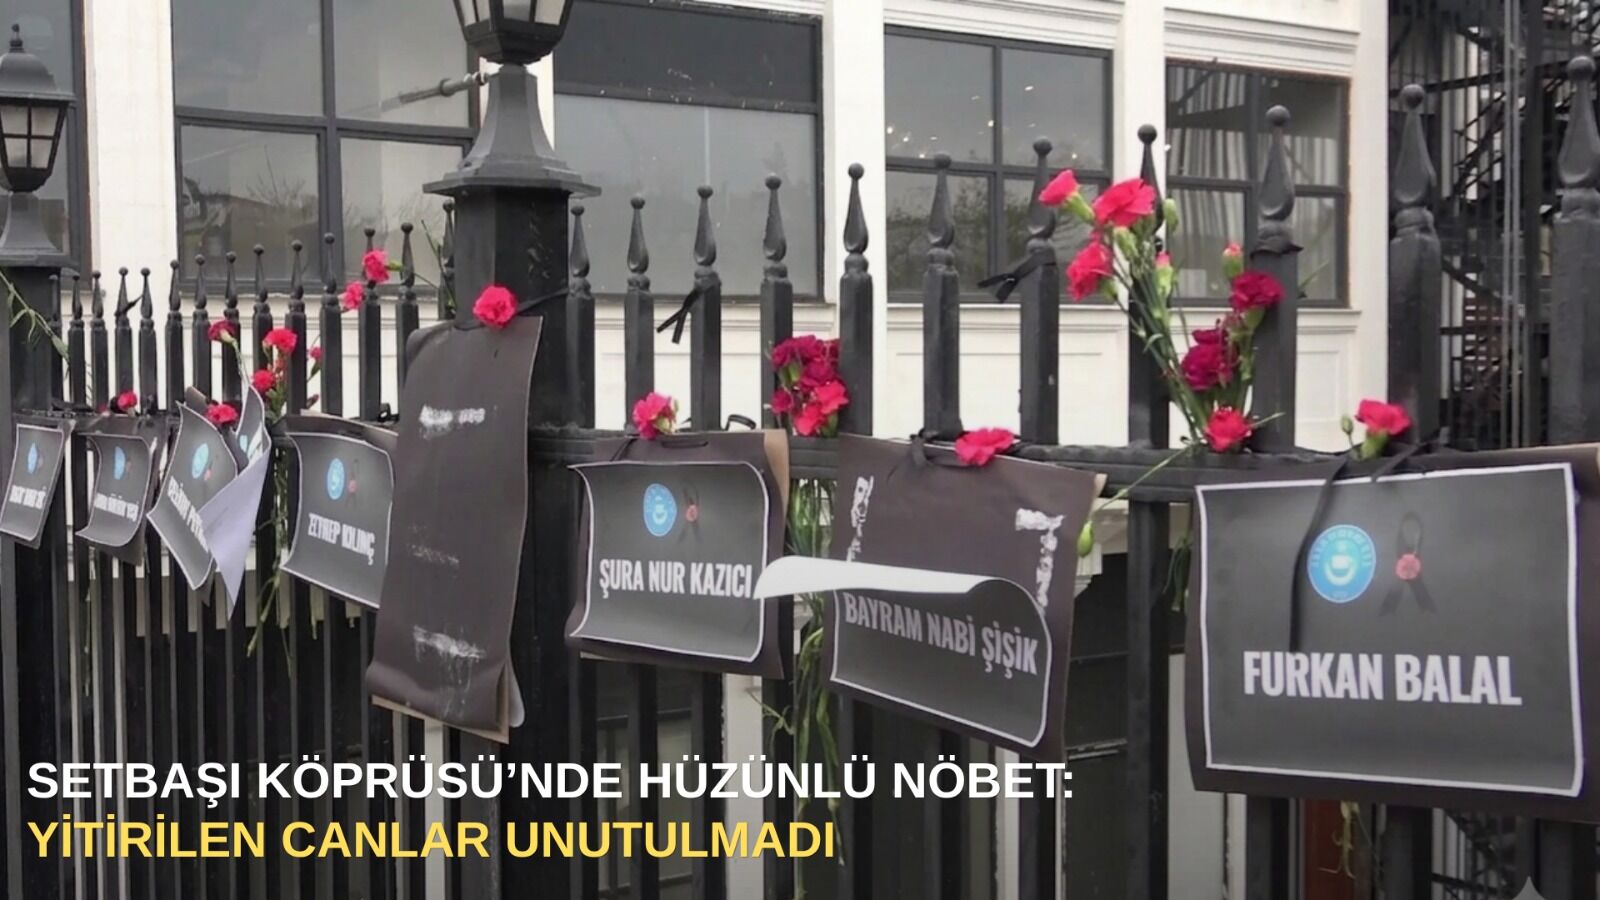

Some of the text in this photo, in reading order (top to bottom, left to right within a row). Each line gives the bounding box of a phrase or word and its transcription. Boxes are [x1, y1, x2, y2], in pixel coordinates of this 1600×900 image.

[599, 558, 753, 599] ŞURA NUR KAZICI
[842, 591, 1039, 680] BAYRAM NABİ ŞİŞİK
[1243, 651, 1523, 706] FURKAN BALAL
